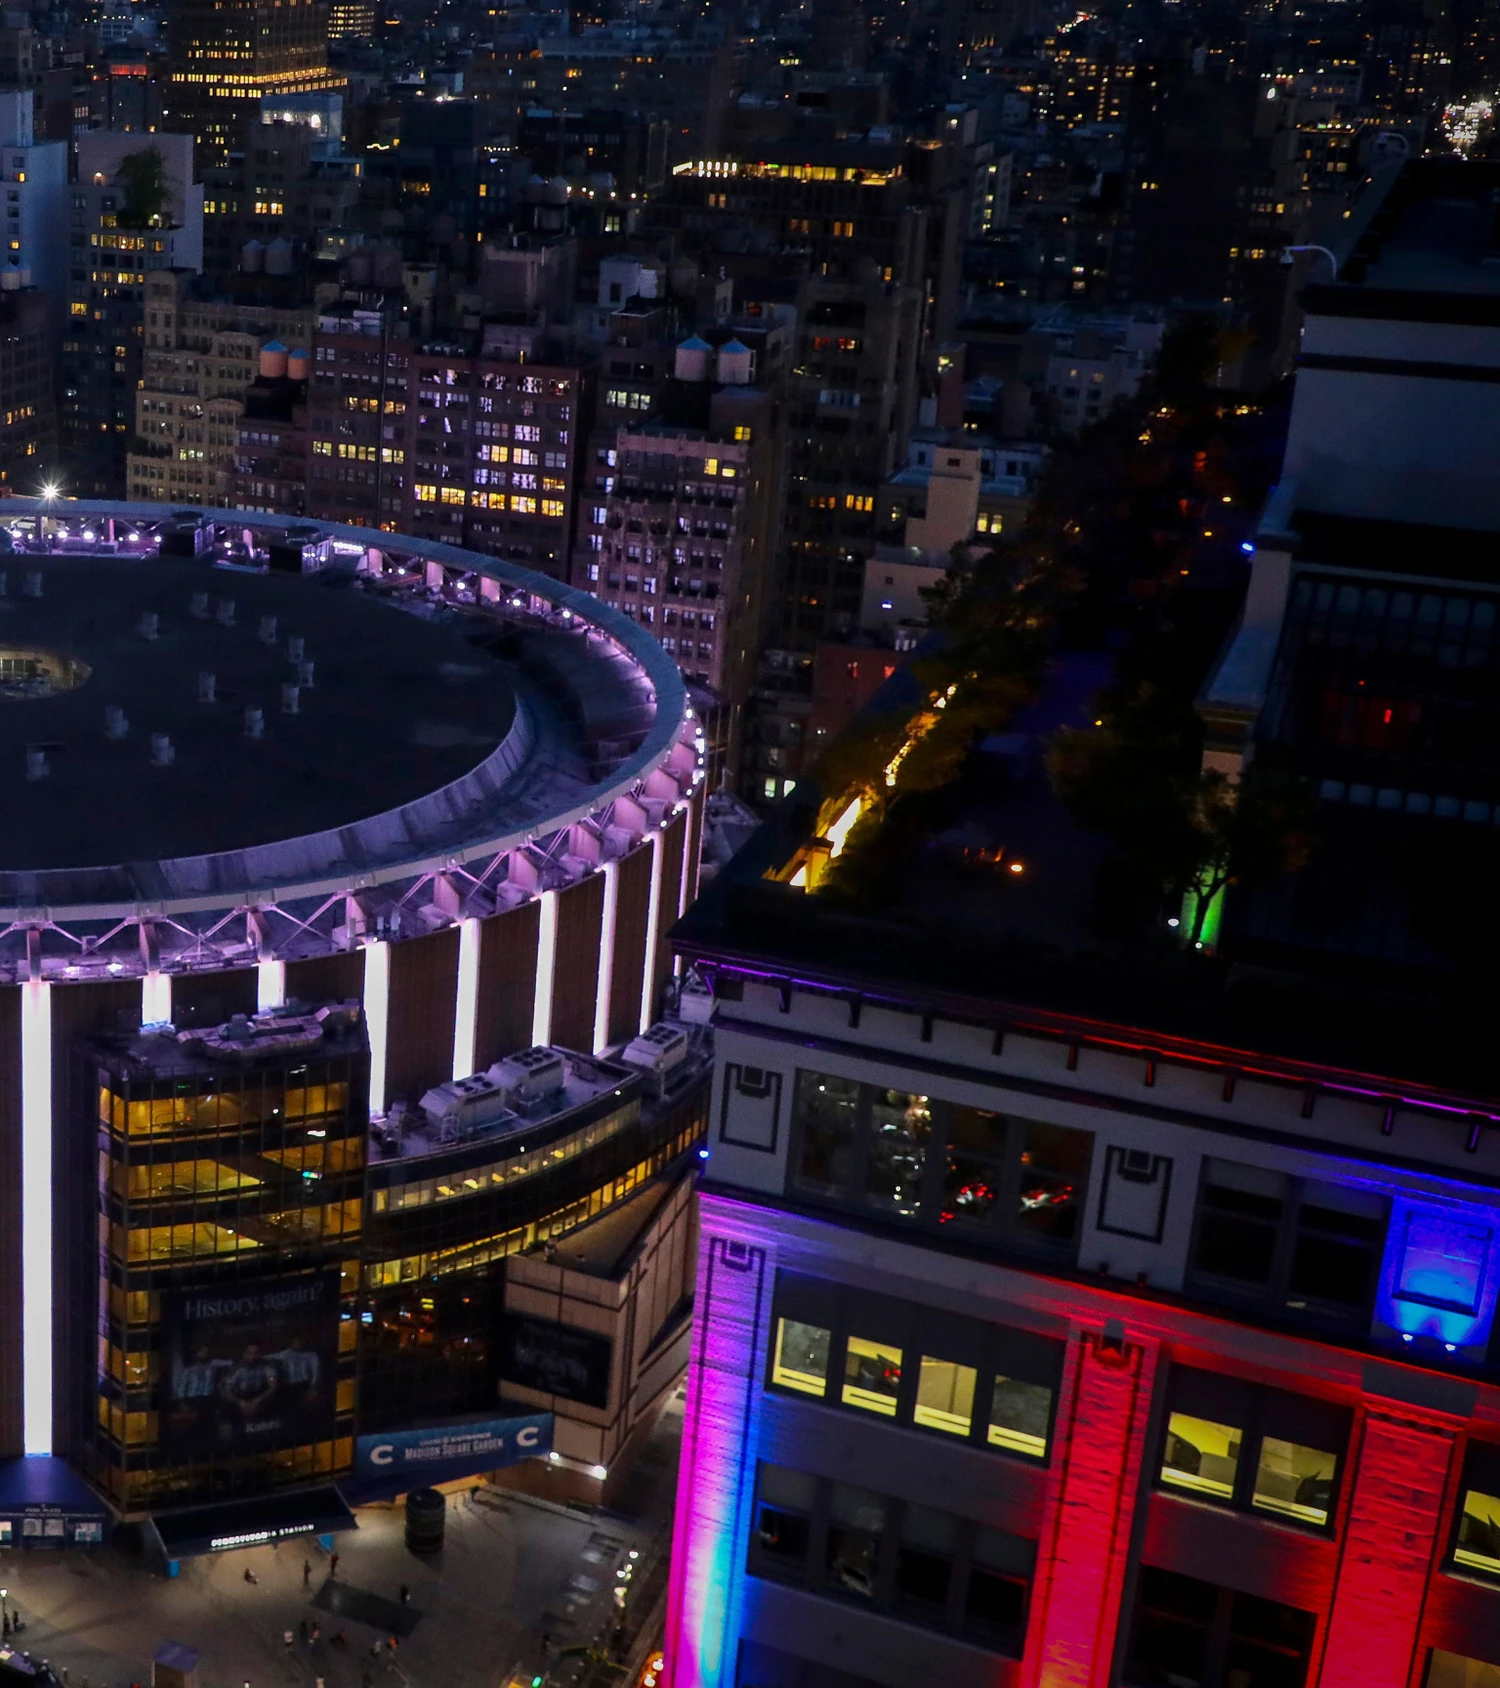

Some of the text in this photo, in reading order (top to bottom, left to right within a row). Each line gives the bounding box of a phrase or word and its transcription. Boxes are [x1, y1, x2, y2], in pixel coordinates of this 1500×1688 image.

[262, 1281, 324, 1311] again?
[473, 1438, 504, 1452] GARDEN
[515, 1426, 540, 1447] C
[370, 1444, 395, 1466] C
